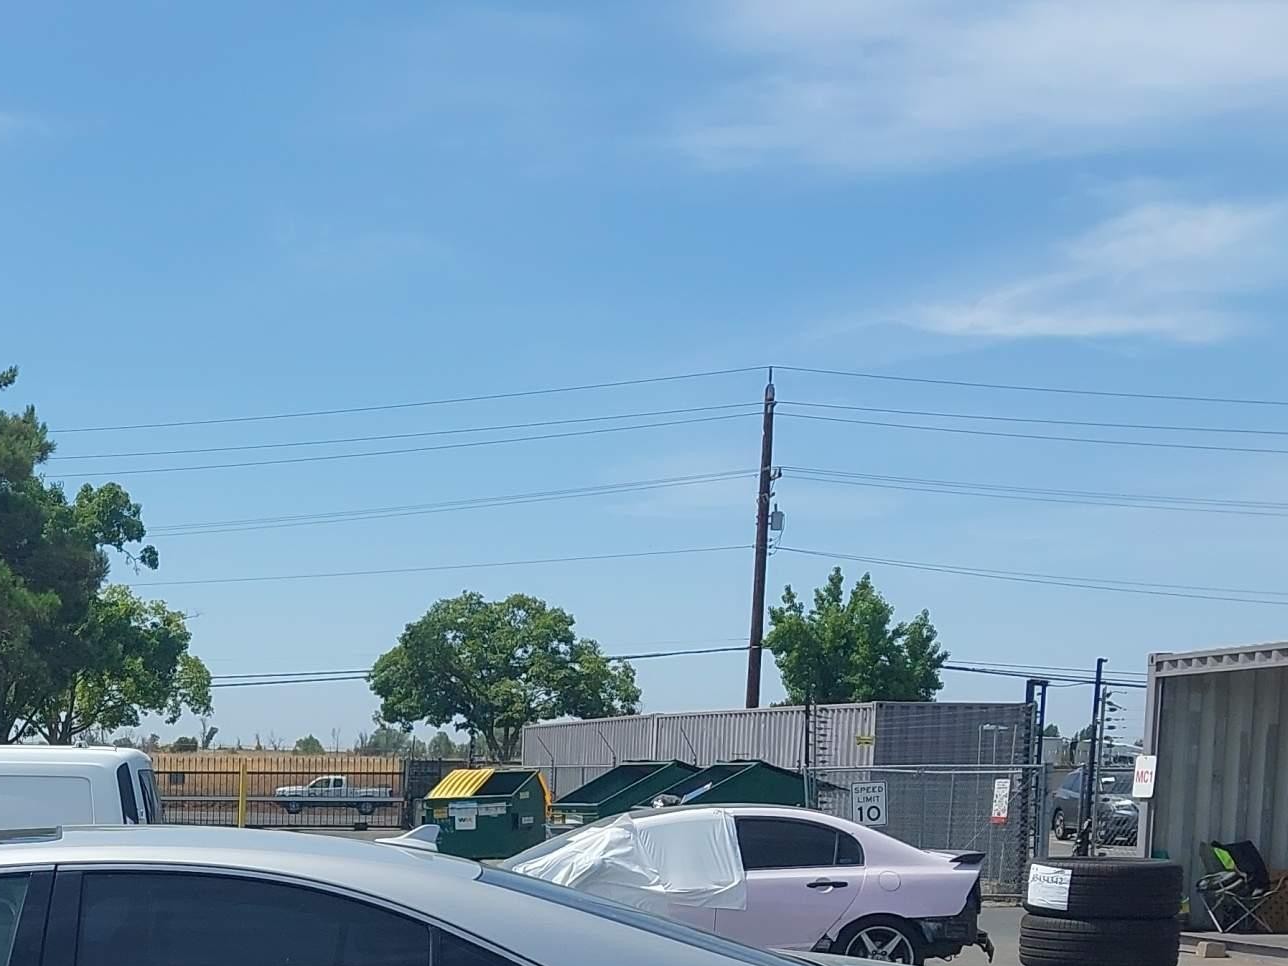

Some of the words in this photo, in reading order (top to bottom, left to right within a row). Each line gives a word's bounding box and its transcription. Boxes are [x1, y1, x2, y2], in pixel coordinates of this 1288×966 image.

[1135, 770, 1153, 784] MC1
[857, 795, 880, 803] LIMIT
[857, 805, 881, 822] 10
